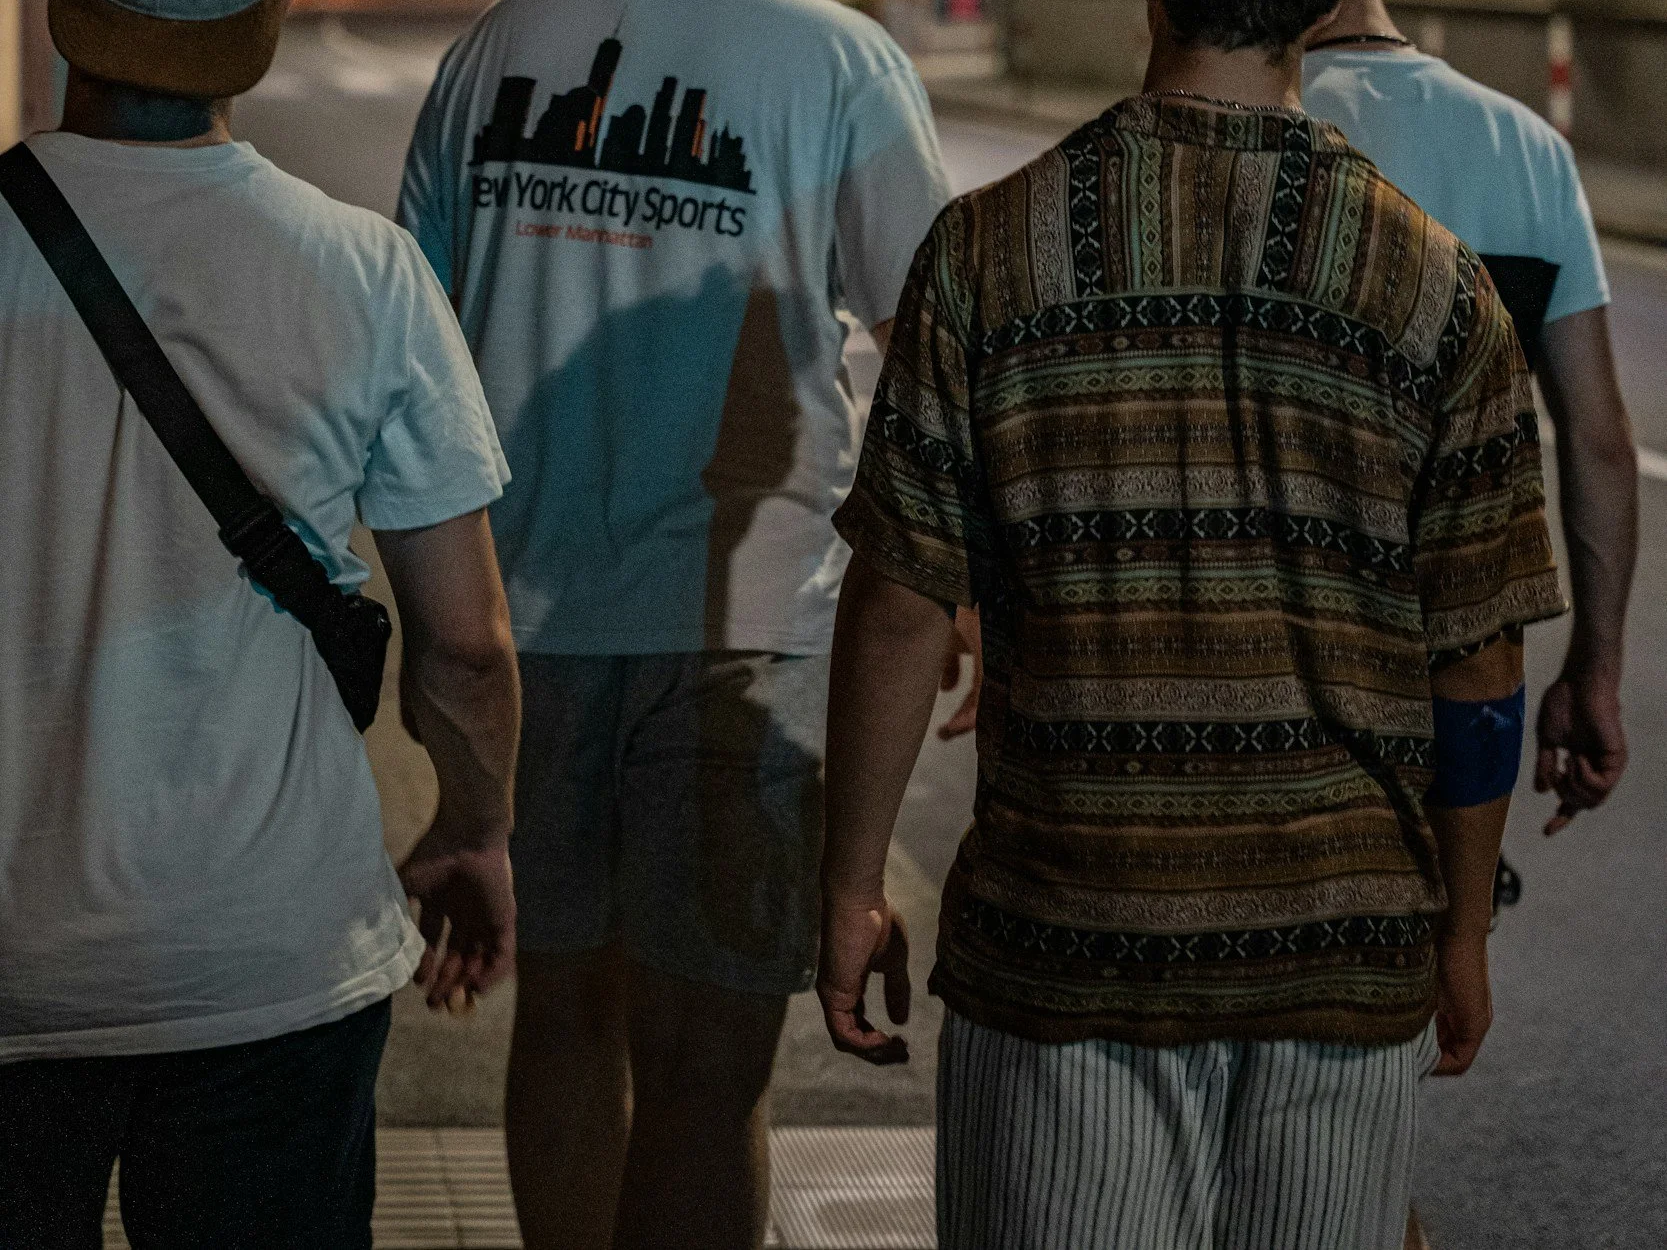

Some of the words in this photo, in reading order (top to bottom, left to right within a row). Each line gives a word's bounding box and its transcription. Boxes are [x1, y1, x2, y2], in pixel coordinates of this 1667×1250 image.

[514, 172, 579, 213] York
[580, 179, 640, 226] City
[641, 187, 747, 237] Sports
